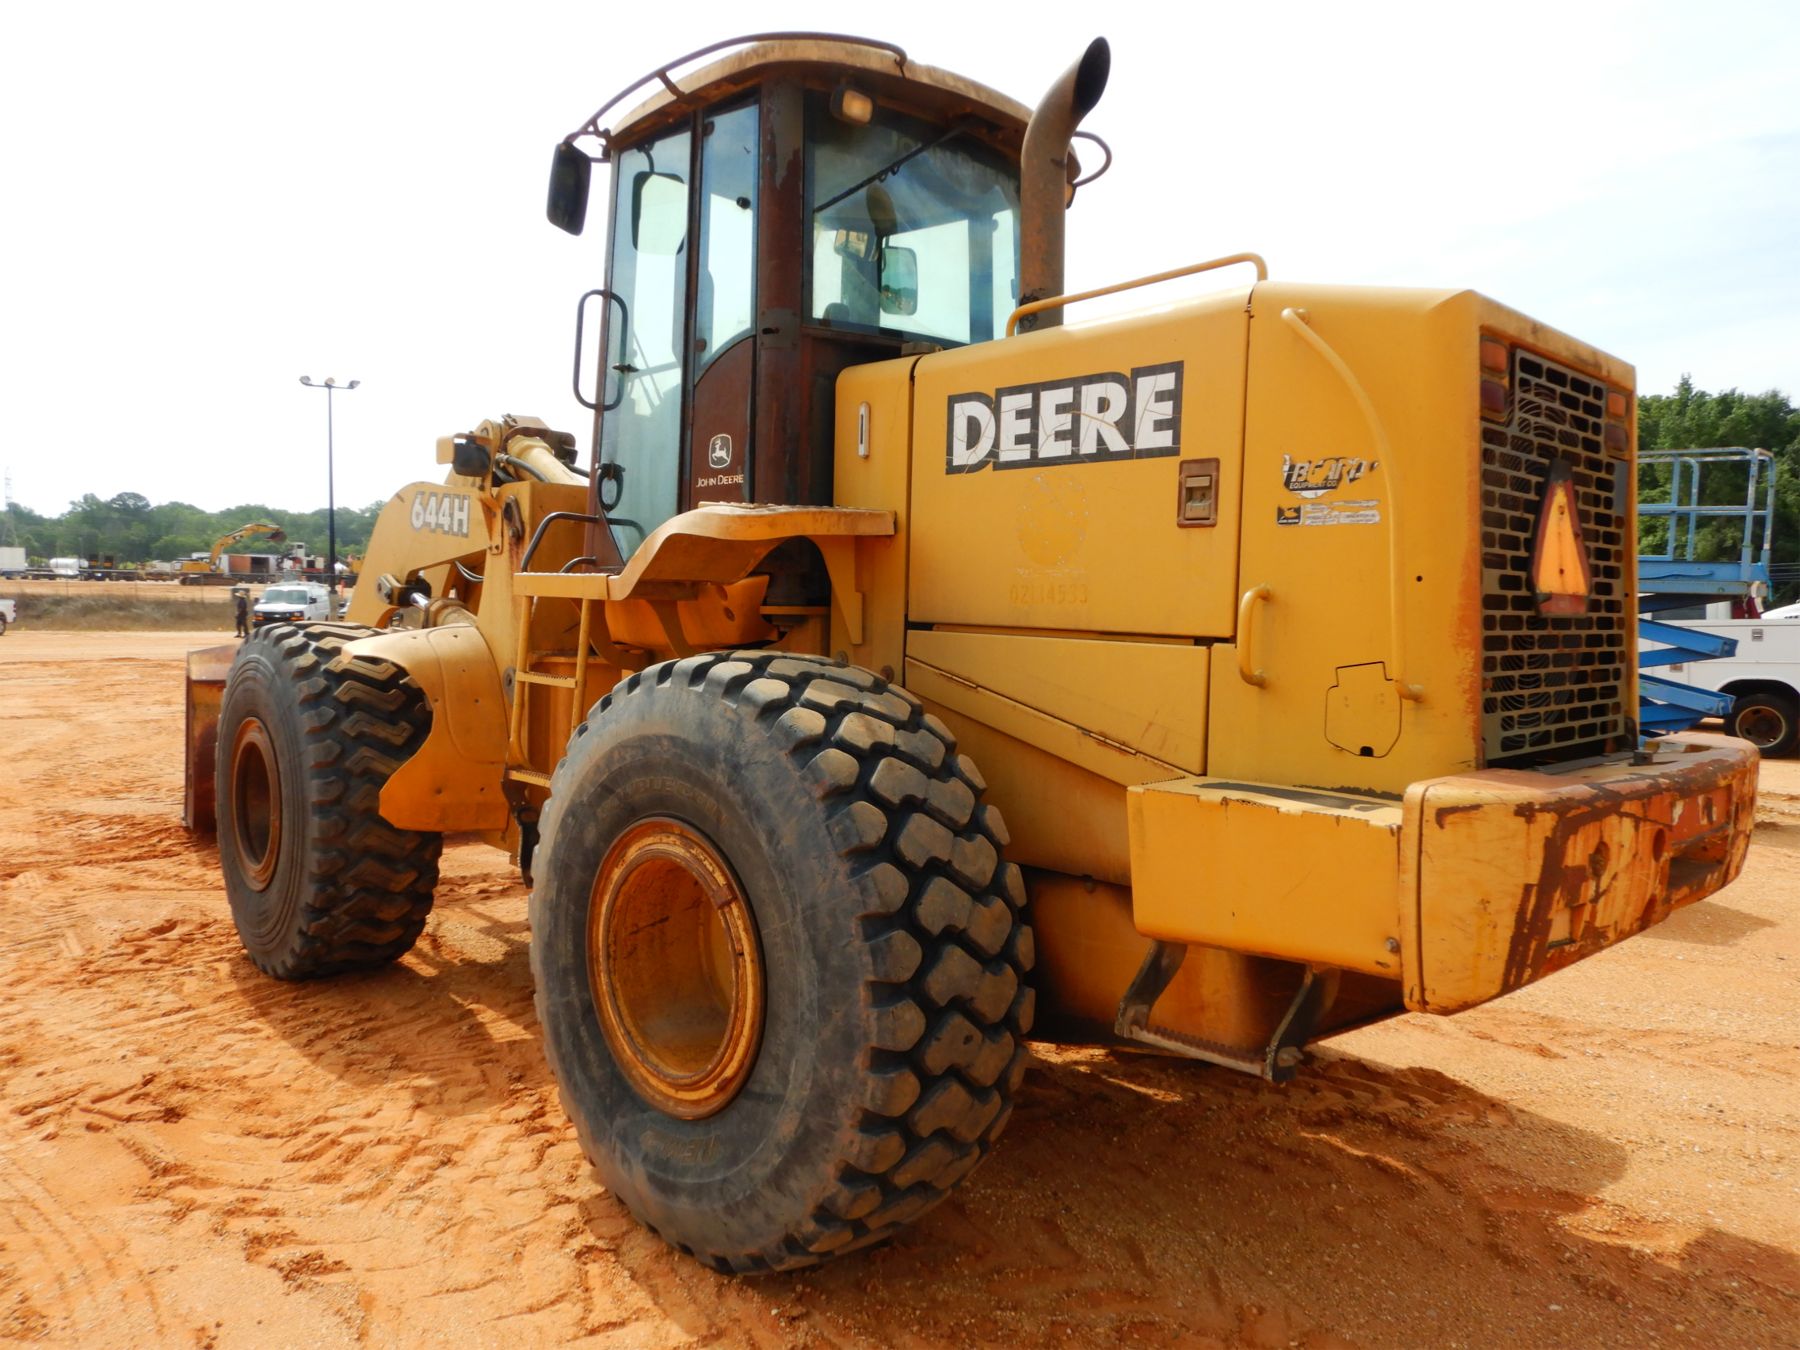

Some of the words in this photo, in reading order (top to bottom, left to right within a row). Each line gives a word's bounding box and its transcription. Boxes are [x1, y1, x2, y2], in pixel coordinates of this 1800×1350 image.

[951, 371, 1177, 467] DEERE
[696, 477, 717, 487] JOHN
[717, 474, 744, 485] DEERE
[411, 492, 470, 537] 644H
